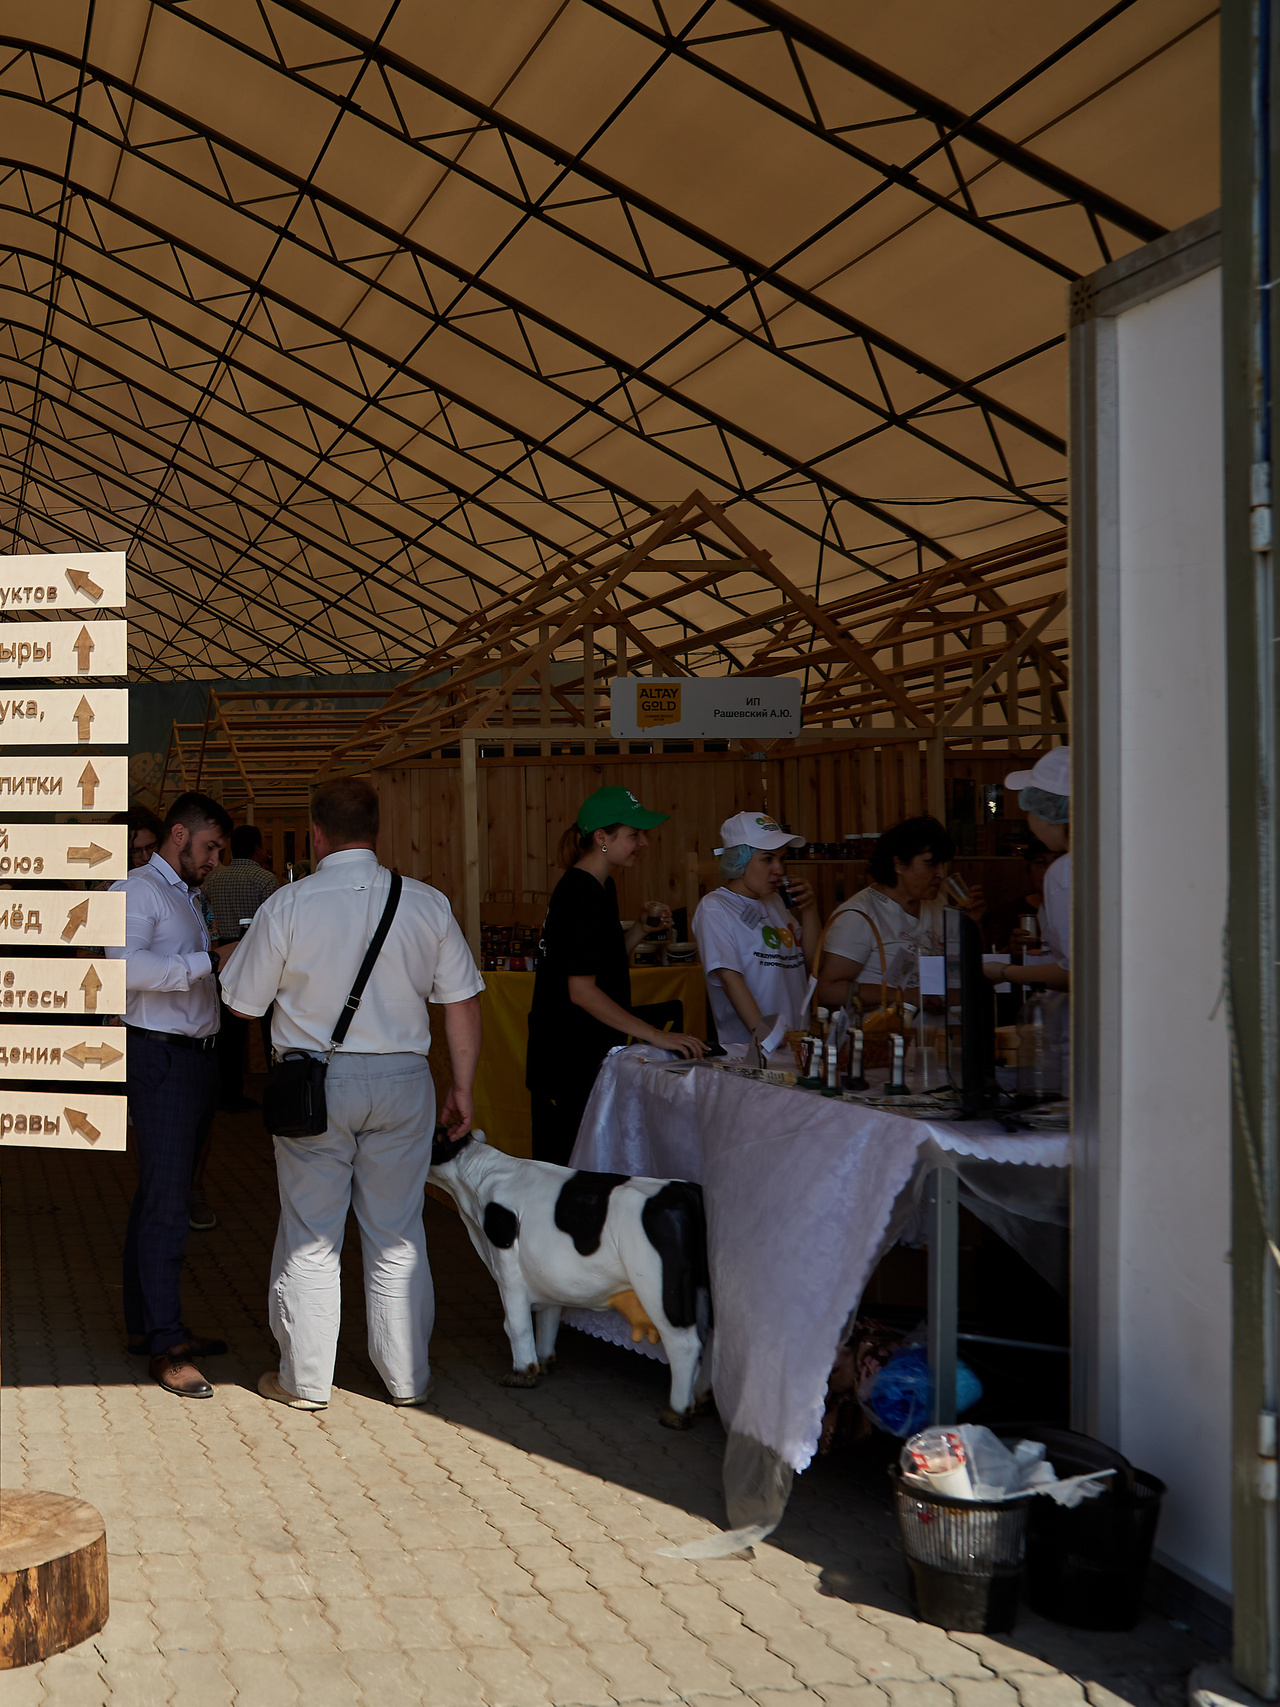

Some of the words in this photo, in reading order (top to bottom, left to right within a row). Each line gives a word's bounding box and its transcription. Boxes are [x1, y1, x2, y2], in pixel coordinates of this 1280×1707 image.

[640, 688, 679, 698] ALTAY
[642, 701, 676, 711] GOLD
[746, 698, 761, 706] ИП
[714, 709, 768, 718] Рашевский
[770, 708, 792, 718] А.Ю.
